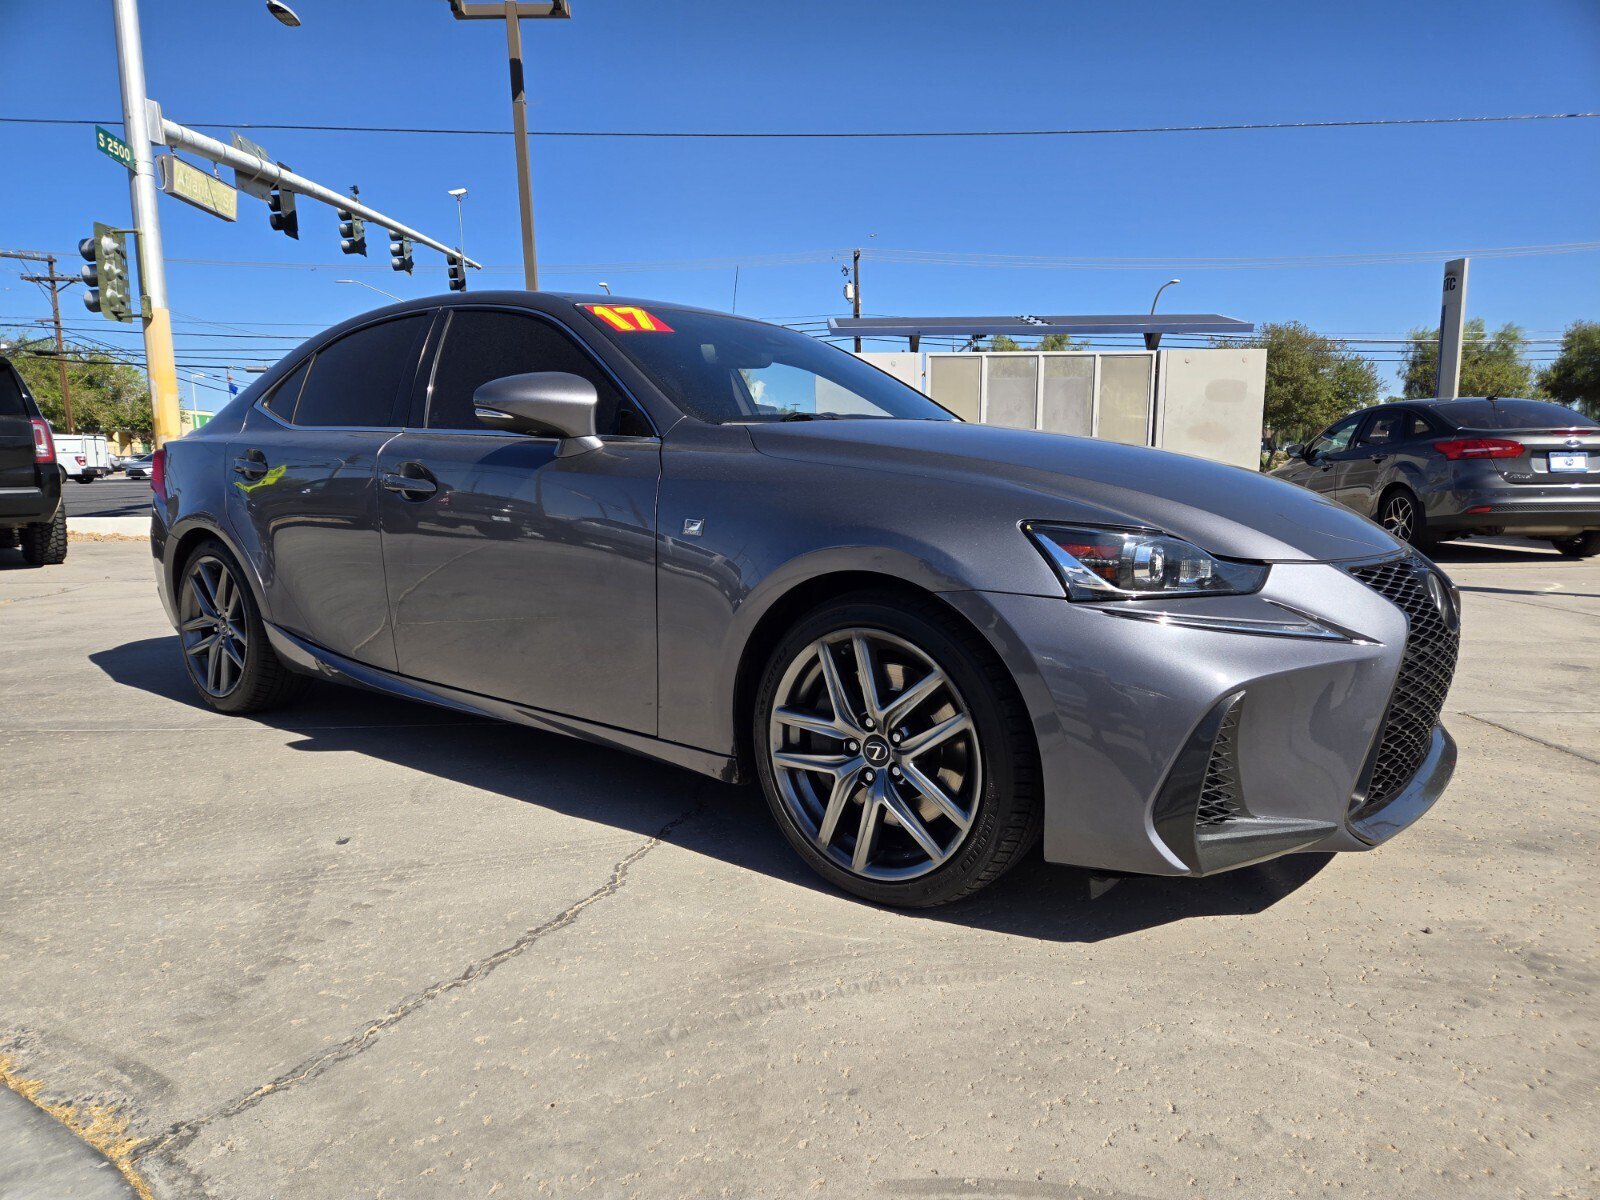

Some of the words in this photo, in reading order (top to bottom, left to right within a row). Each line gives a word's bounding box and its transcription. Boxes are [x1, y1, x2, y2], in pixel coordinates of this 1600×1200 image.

[98, 132, 105, 148] S
[107, 137, 130, 162] 2500
[593, 306, 656, 330] 17
